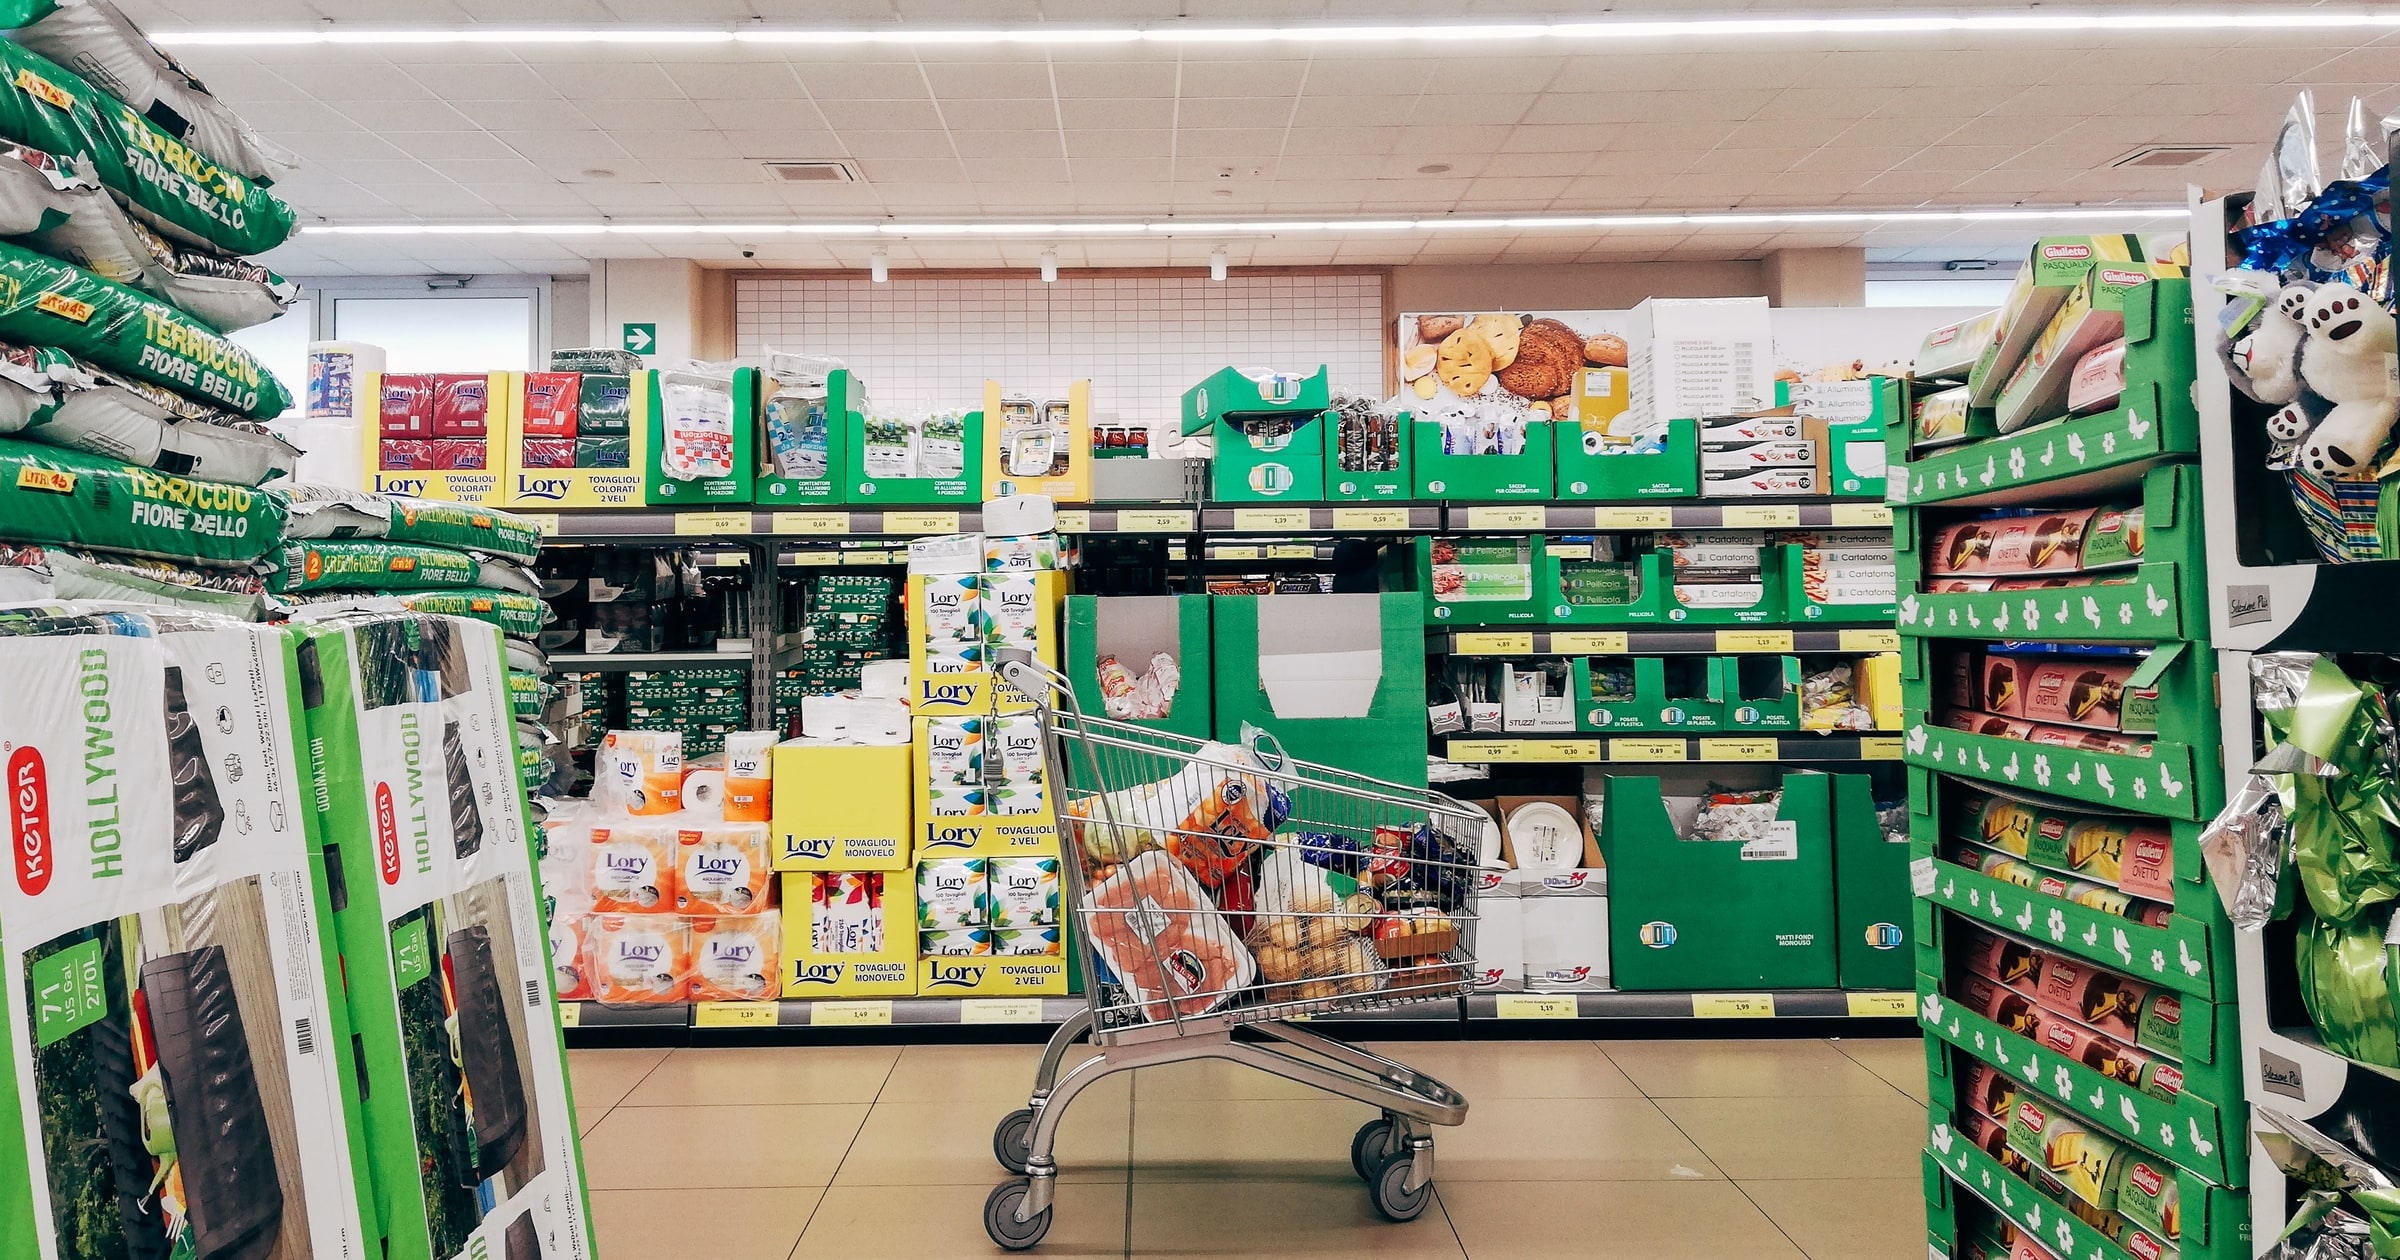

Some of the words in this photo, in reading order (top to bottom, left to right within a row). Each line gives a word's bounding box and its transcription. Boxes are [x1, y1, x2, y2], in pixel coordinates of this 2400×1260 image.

[125, 147, 182, 198] FIORE
[184, 182, 246, 230] BELLO
[2043, 245, 2089, 258] Giulietta
[2102, 270, 2147, 283] Giulietta
[142, 308, 260, 389] TERRICCIO
[138, 344, 199, 388] FIORE
[200, 370, 258, 413] BELLO
[2080, 368, 2107, 390] OVETTO
[529, 381, 559, 396] Lory
[600, 384, 630, 399] Lory
[1827, 385, 1865, 394] Alluminio
[1828, 399, 1866, 408] Alluminio
[778, 431, 787, 442] 2
[385, 450, 415, 466] Lory
[452, 453, 483, 468] Lory
[596, 449, 627, 464] Lory
[24, 469, 48, 486] LITRI
[49, 473, 69, 490] 45
[374, 474, 428, 498] Lory
[444, 475, 497, 484] TOVAGLIOLI
[517, 474, 572, 499] Lory
[588, 475, 641, 485] TOVAGLIOLI
[122, 466, 252, 514] TERRICCIO
[449, 484, 492, 493] COLORATI
[592, 484, 636, 494] COLORATI
[457, 494, 463, 502] 2
[463, 494, 483, 502] VELI
[600, 494, 607, 503] 2
[607, 494, 627, 503] VELI
[131, 501, 190, 531] FIORE
[191, 513, 249, 539] BELLO
[1839, 534, 1887, 544] Cartaforno
[1476, 546, 1511, 555] Pellicola
[1709, 552, 1755, 563] Cartaforno
[1841, 552, 1888, 562] Cartaforno
[1997, 547, 2020, 560] OVETTO
[309, 559, 319, 574] 2
[1008, 559, 1032, 568] Lory
[419, 569, 443, 582] FIORE
[444, 568, 471, 583] BELLO
[1483, 572, 1519, 582] Pellicola
[1848, 569, 1896, 578] Cartaforno
[1586, 579, 1621, 588] Pellicola
[930, 592, 961, 607] Lory
[1000, 591, 1033, 606] Lory
[1586, 595, 1621, 604] Pellicola
[1711, 589, 1757, 598] Cartaforno
[1849, 587, 1897, 597] Cartaforno
[933, 662, 964, 673] Lory
[921, 680, 978, 705] Lory
[2035, 694, 2058, 707] OVETTO
[1508, 718, 1536, 727] STUZZI
[932, 734, 963, 750] Lory
[1007, 735, 1039, 750] Lory
[79, 648, 124, 880] HOLLYWOOD
[734, 758, 758, 772] Lory
[310, 736, 330, 814] HOLLYWOOD
[400, 712, 432, 874] HOLLYWOOD
[926, 823, 982, 848] Lory
[995, 825, 1056, 836] TOVAGLIOLI
[1010, 836, 1016, 845] 2
[1017, 836, 1040, 846] VELI
[785, 834, 836, 858] Lory
[844, 839, 896, 848] TOVAGLIOLI
[845, 849, 896, 857] MONOVELO
[607, 853, 648, 873] Lory
[695, 854, 741, 875] Lory
[2132, 865, 2160, 880] OVETTO
[936, 875, 968, 891] Lory
[1007, 875, 1039, 891] Lory
[410, 932, 418, 952] Gal
[1641, 924, 1675, 945] WIT
[1775, 933, 1794, 941] PIATTI
[1794, 933, 1814, 941] FONDI
[1866, 925, 1900, 945] WIT
[621, 941, 664, 960] Lory
[712, 941, 755, 960] Lory
[400, 945, 414, 973] 71
[414, 954, 422, 973] US
[62, 965, 73, 995] Gal
[83, 950, 101, 1010] 270L
[795, 960, 846, 986] Lory
[854, 963, 906, 973] TOVAGLIOLI
[855, 973, 906, 983] MONOVELO
[930, 961, 986, 987] Lory
[1000, 965, 1060, 975] TOVAGLIOLI
[1014, 976, 1021, 985] 2
[1022, 976, 1045, 985] VELI
[2047, 983, 2071, 1001] OVETTO
[41, 982, 62, 1024] 71
[65, 998, 77, 1023] US
[1540, 1004, 1554, 1012] 1,19
[1736, 1003, 1750, 1011] 1,99
[1891, 1002, 1905, 1010] 1,99
[740, 1011, 754, 1019] 1,19
[854, 1010, 868, 1018] 1,49
[2018, 1106, 2046, 1129] Giulietta
[2013, 1122, 2043, 1149] PASQUALINA
[2131, 1166, 2162, 1192] Giulietta
[2125, 1184, 2158, 1215] PASQUALINA
